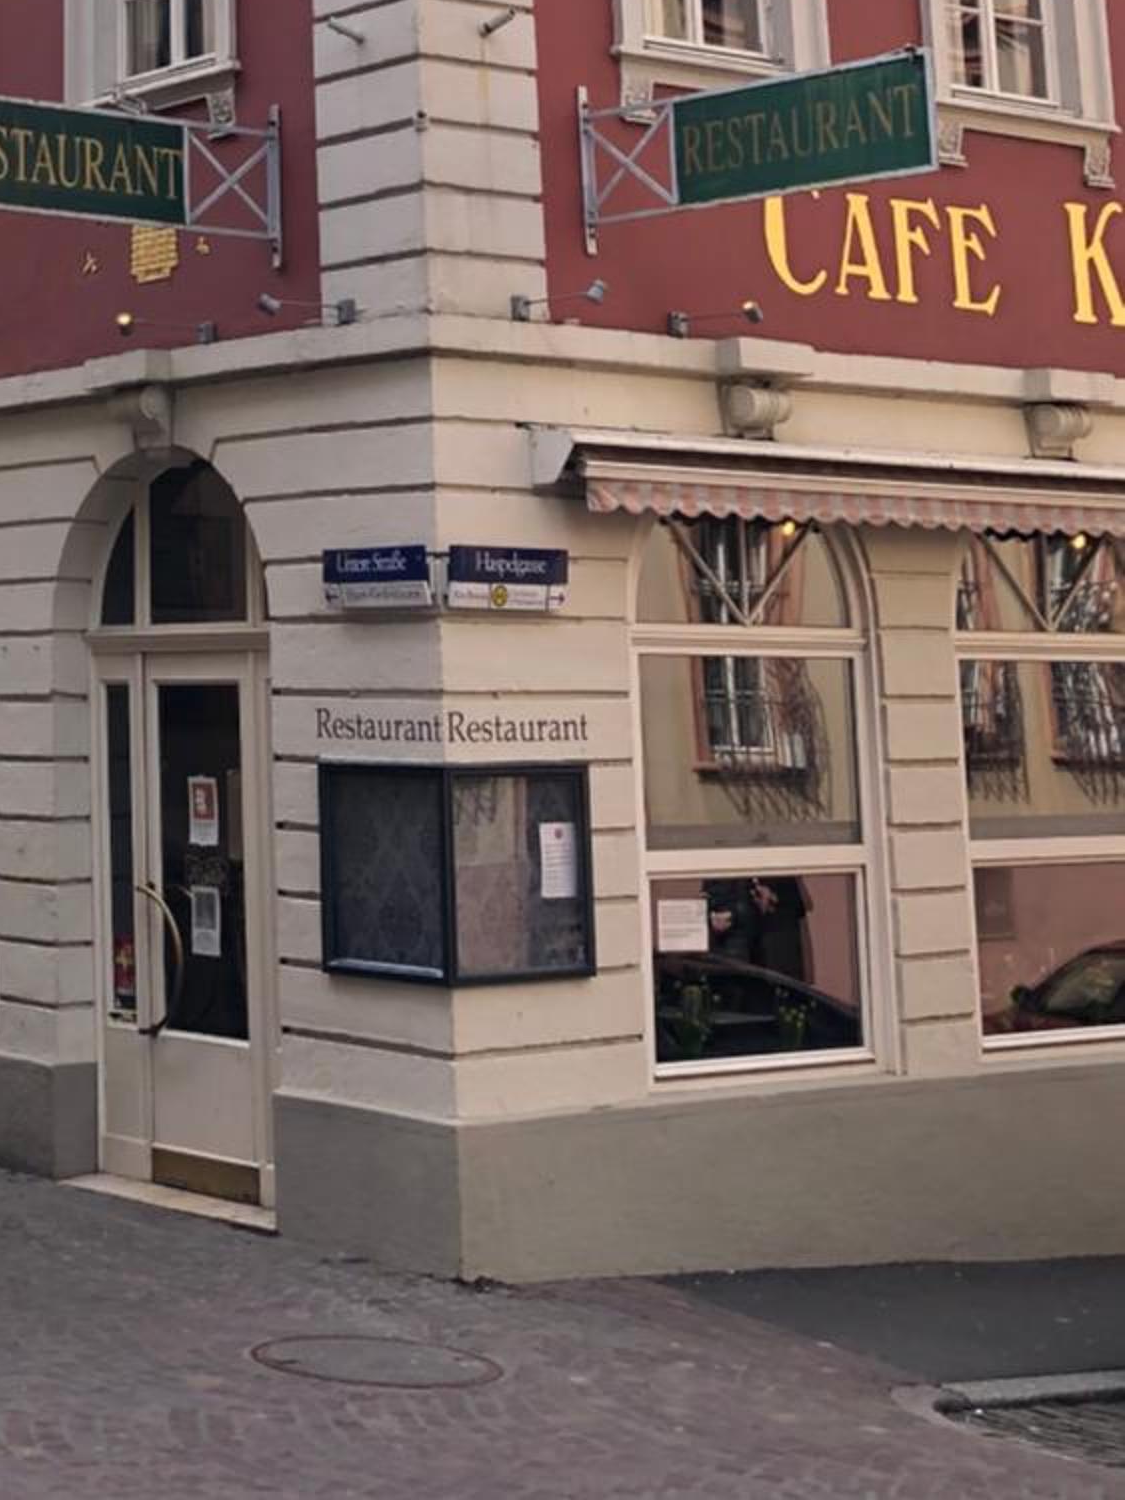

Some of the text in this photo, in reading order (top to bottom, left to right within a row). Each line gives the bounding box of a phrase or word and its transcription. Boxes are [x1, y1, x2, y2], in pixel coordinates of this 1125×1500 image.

[682, 83, 917, 176] RESTAURANT
[764, 190, 1001, 316] CAFE
[315, 707, 442, 742] Restaurant
[447, 711, 588, 742] Restaurant
